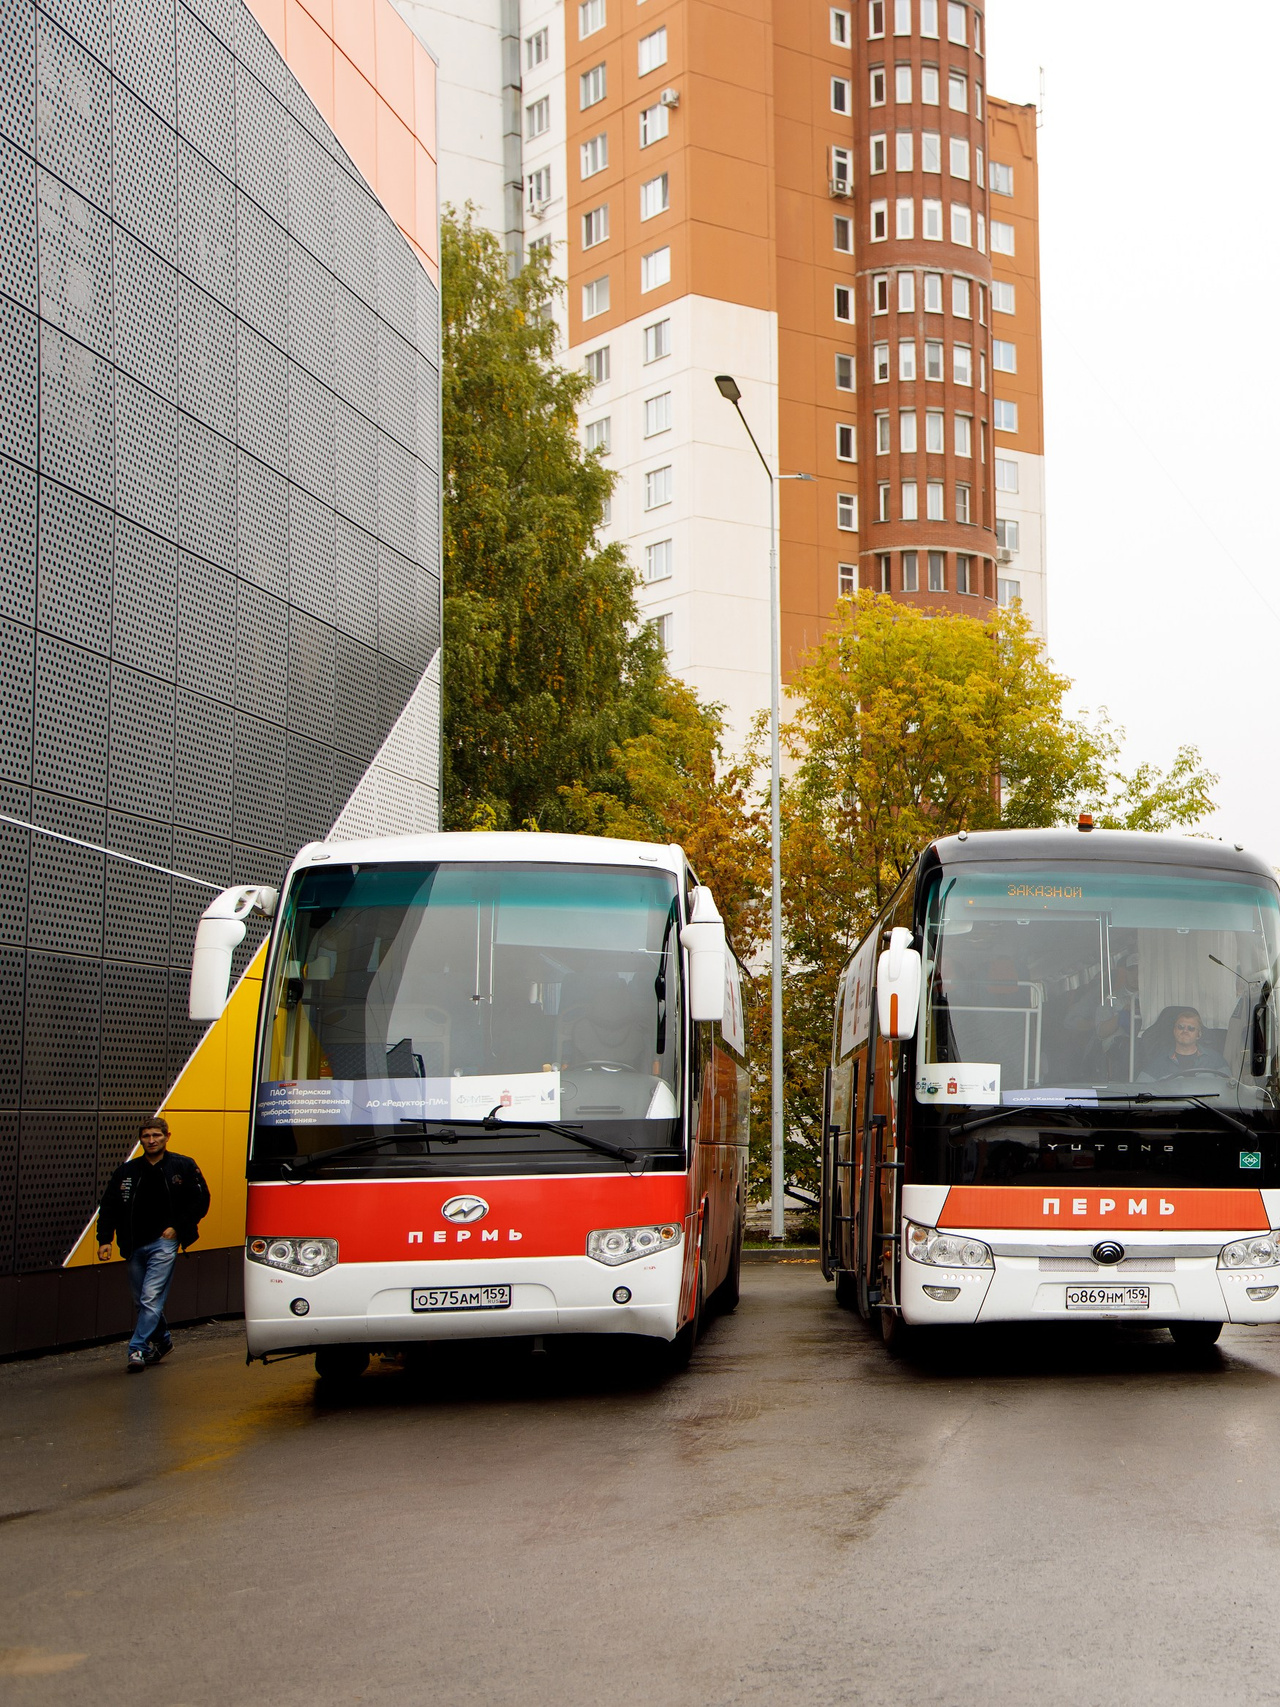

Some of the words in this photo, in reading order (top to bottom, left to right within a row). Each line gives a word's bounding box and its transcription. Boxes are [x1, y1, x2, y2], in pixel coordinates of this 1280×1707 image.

[1007, 884, 1082, 898] ЗАКАЗНОЙ
[270, 1088, 286, 1097] ПАО
[287, 1088, 332, 1097] «Пермская
[366, 1099, 380, 1108] АО
[382, 1097, 449, 1108] «Редуктор-ПМ»
[261, 1107, 341, 1118] приборостроительная
[275, 1117, 317, 1125] компания»
[1047, 1144, 1174, 1152] YUTONG
[1042, 1198, 1175, 1216] ПЕРМЬ
[408, 1228, 523, 1244] ПЕРМЬ
[483, 1288, 505, 1300] 159
[1126, 1288, 1145, 1299] 159
